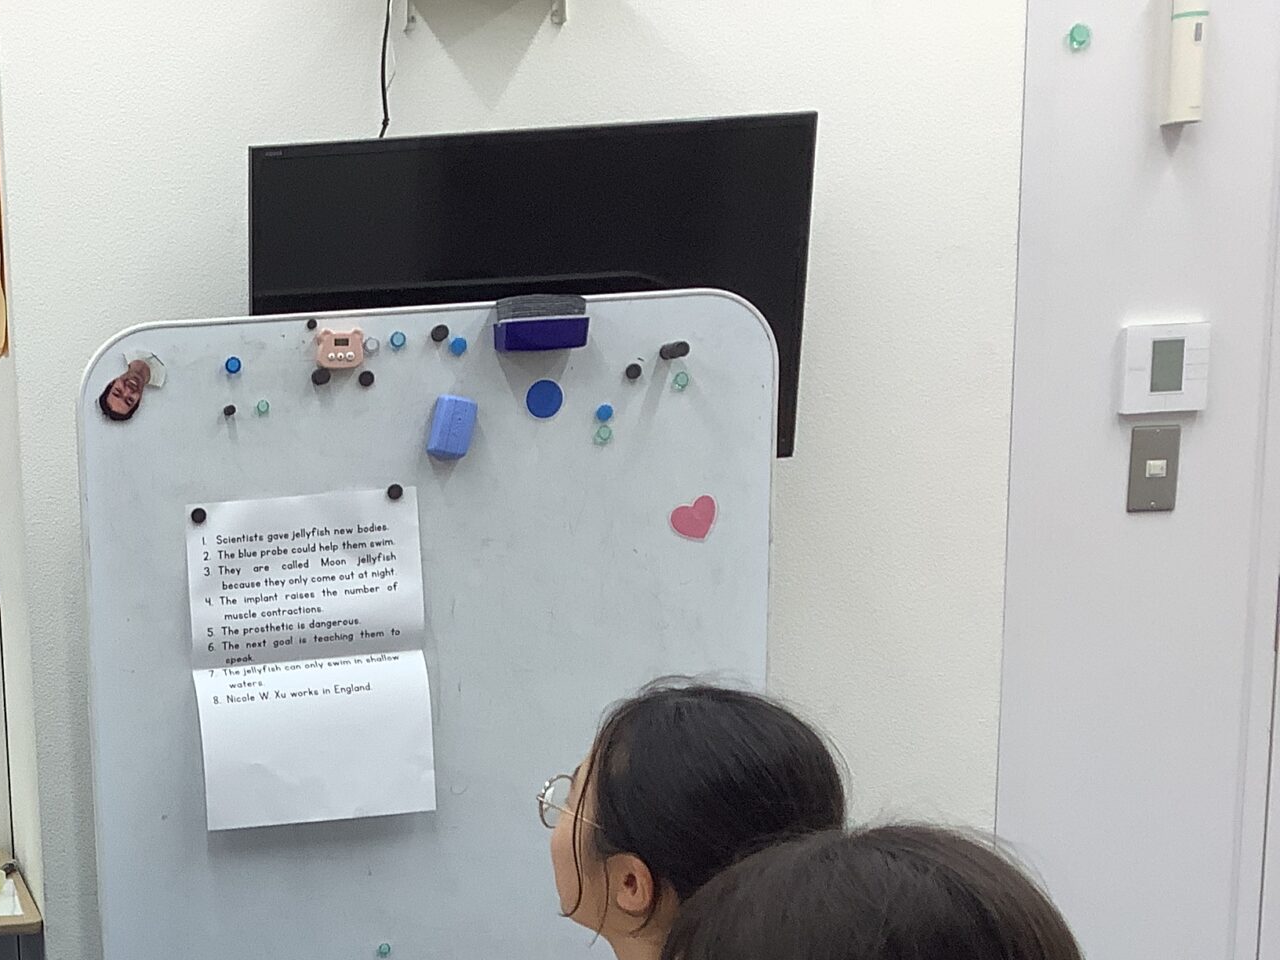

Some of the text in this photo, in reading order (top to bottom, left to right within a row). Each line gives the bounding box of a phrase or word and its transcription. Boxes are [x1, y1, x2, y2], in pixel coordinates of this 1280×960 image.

[216, 533, 264, 545] Scientists
[267, 533, 289, 543] gave
[291, 527, 330, 541] jellyfish
[333, 527, 353, 535] new
[357, 523, 389, 534] bodies.
[217, 550, 235, 559] The
[238, 549, 257, 558] blue
[261, 546, 288, 558] probe
[291, 543, 316, 554] could
[319, 542, 339, 552] help
[342, 541, 367, 550] them
[370, 538, 395, 548] swim.
[218, 566, 241, 576] They
[282, 559, 309, 570] called
[320, 557, 346, 567] Moon
[357, 551, 397, 566] jellyfish
[222, 581, 261, 590] because
[264, 578, 285, 588] they
[288, 575, 308, 585] only
[311, 575, 336, 583] come
[339, 571, 354, 580] out
[358, 570, 368, 578] at
[219, 596, 237, 605] The
[244, 593, 278, 605] implant
[285, 591, 315, 600] raises
[322, 588, 337, 597] the
[344, 585, 380, 595] number
[387, 581, 398, 591] of
[224, 606, 323, 620] muscle contractions.
[221, 626, 239, 636] The
[243, 622, 293, 636] prosthetic
[309, 618, 361, 630] dangerous.
[222, 641, 240, 650] The
[246, 639, 267, 648] next
[273, 636, 293, 648] goal
[314, 632, 353, 643] teaching
[360, 629, 384, 639] them
[391, 628, 400, 636] to
[243, 665, 281, 676] jellyfish
[304, 661, 323, 669] only
[327, 659, 351, 667] swim
[366, 654, 400, 663] shallow
[226, 693, 255, 703] Nicole
[274, 690, 286, 699] Xu
[290, 688, 318, 698] works
[334, 682, 372, 695] England.
